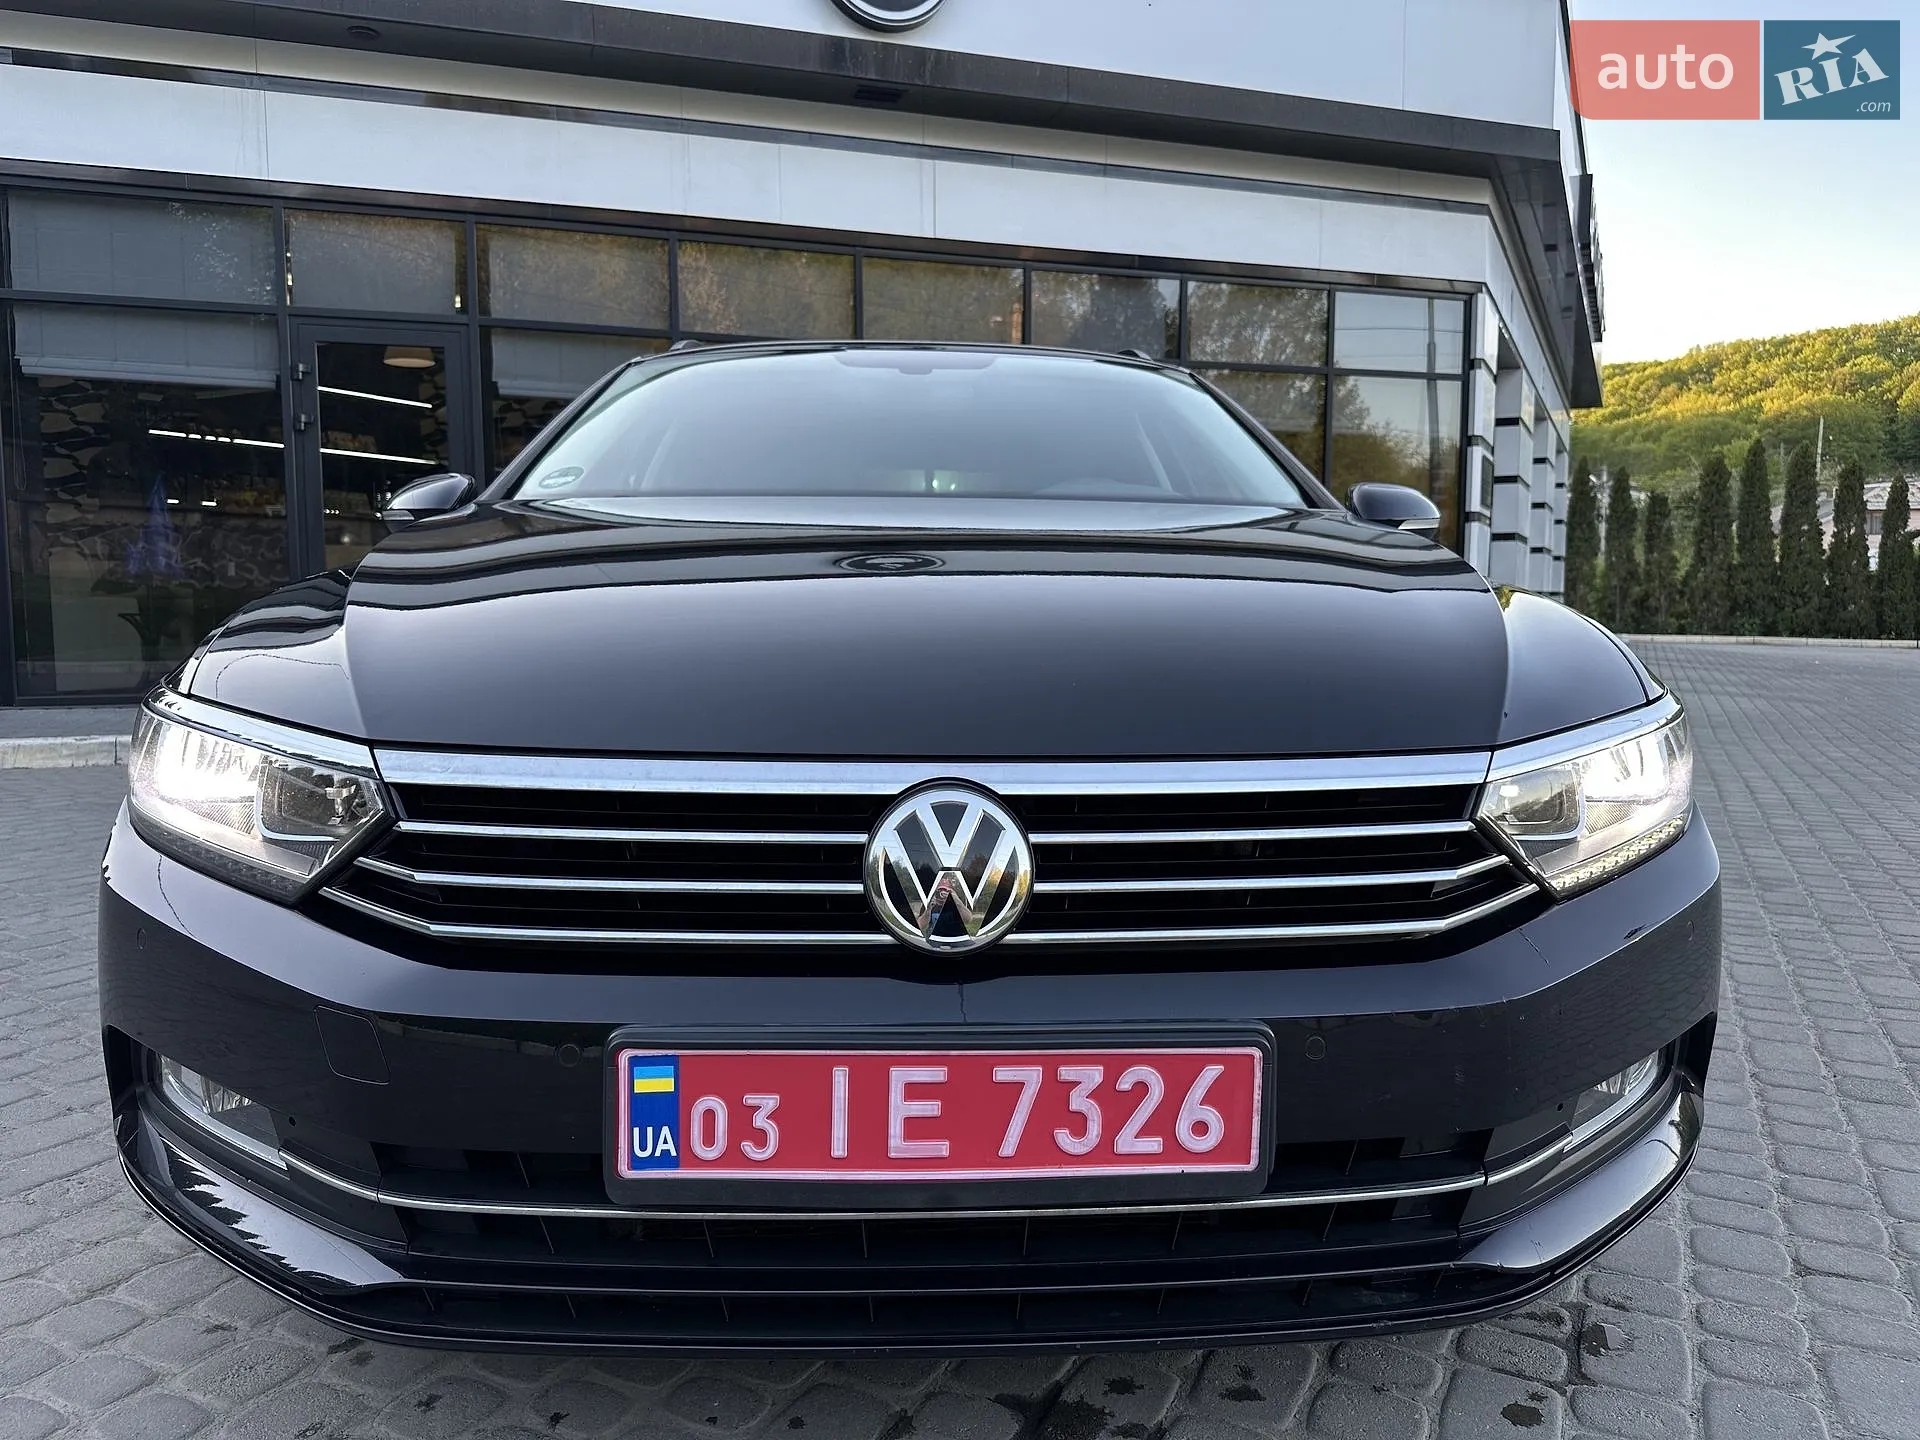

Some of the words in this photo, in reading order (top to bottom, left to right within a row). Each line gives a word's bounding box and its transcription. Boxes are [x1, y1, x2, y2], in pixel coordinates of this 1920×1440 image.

[632, 1126, 677, 1158] UA
[690, 1096, 779, 1161] 03
[831, 1066, 950, 1158] IE
[993, 1065, 1225, 1157] 7326
